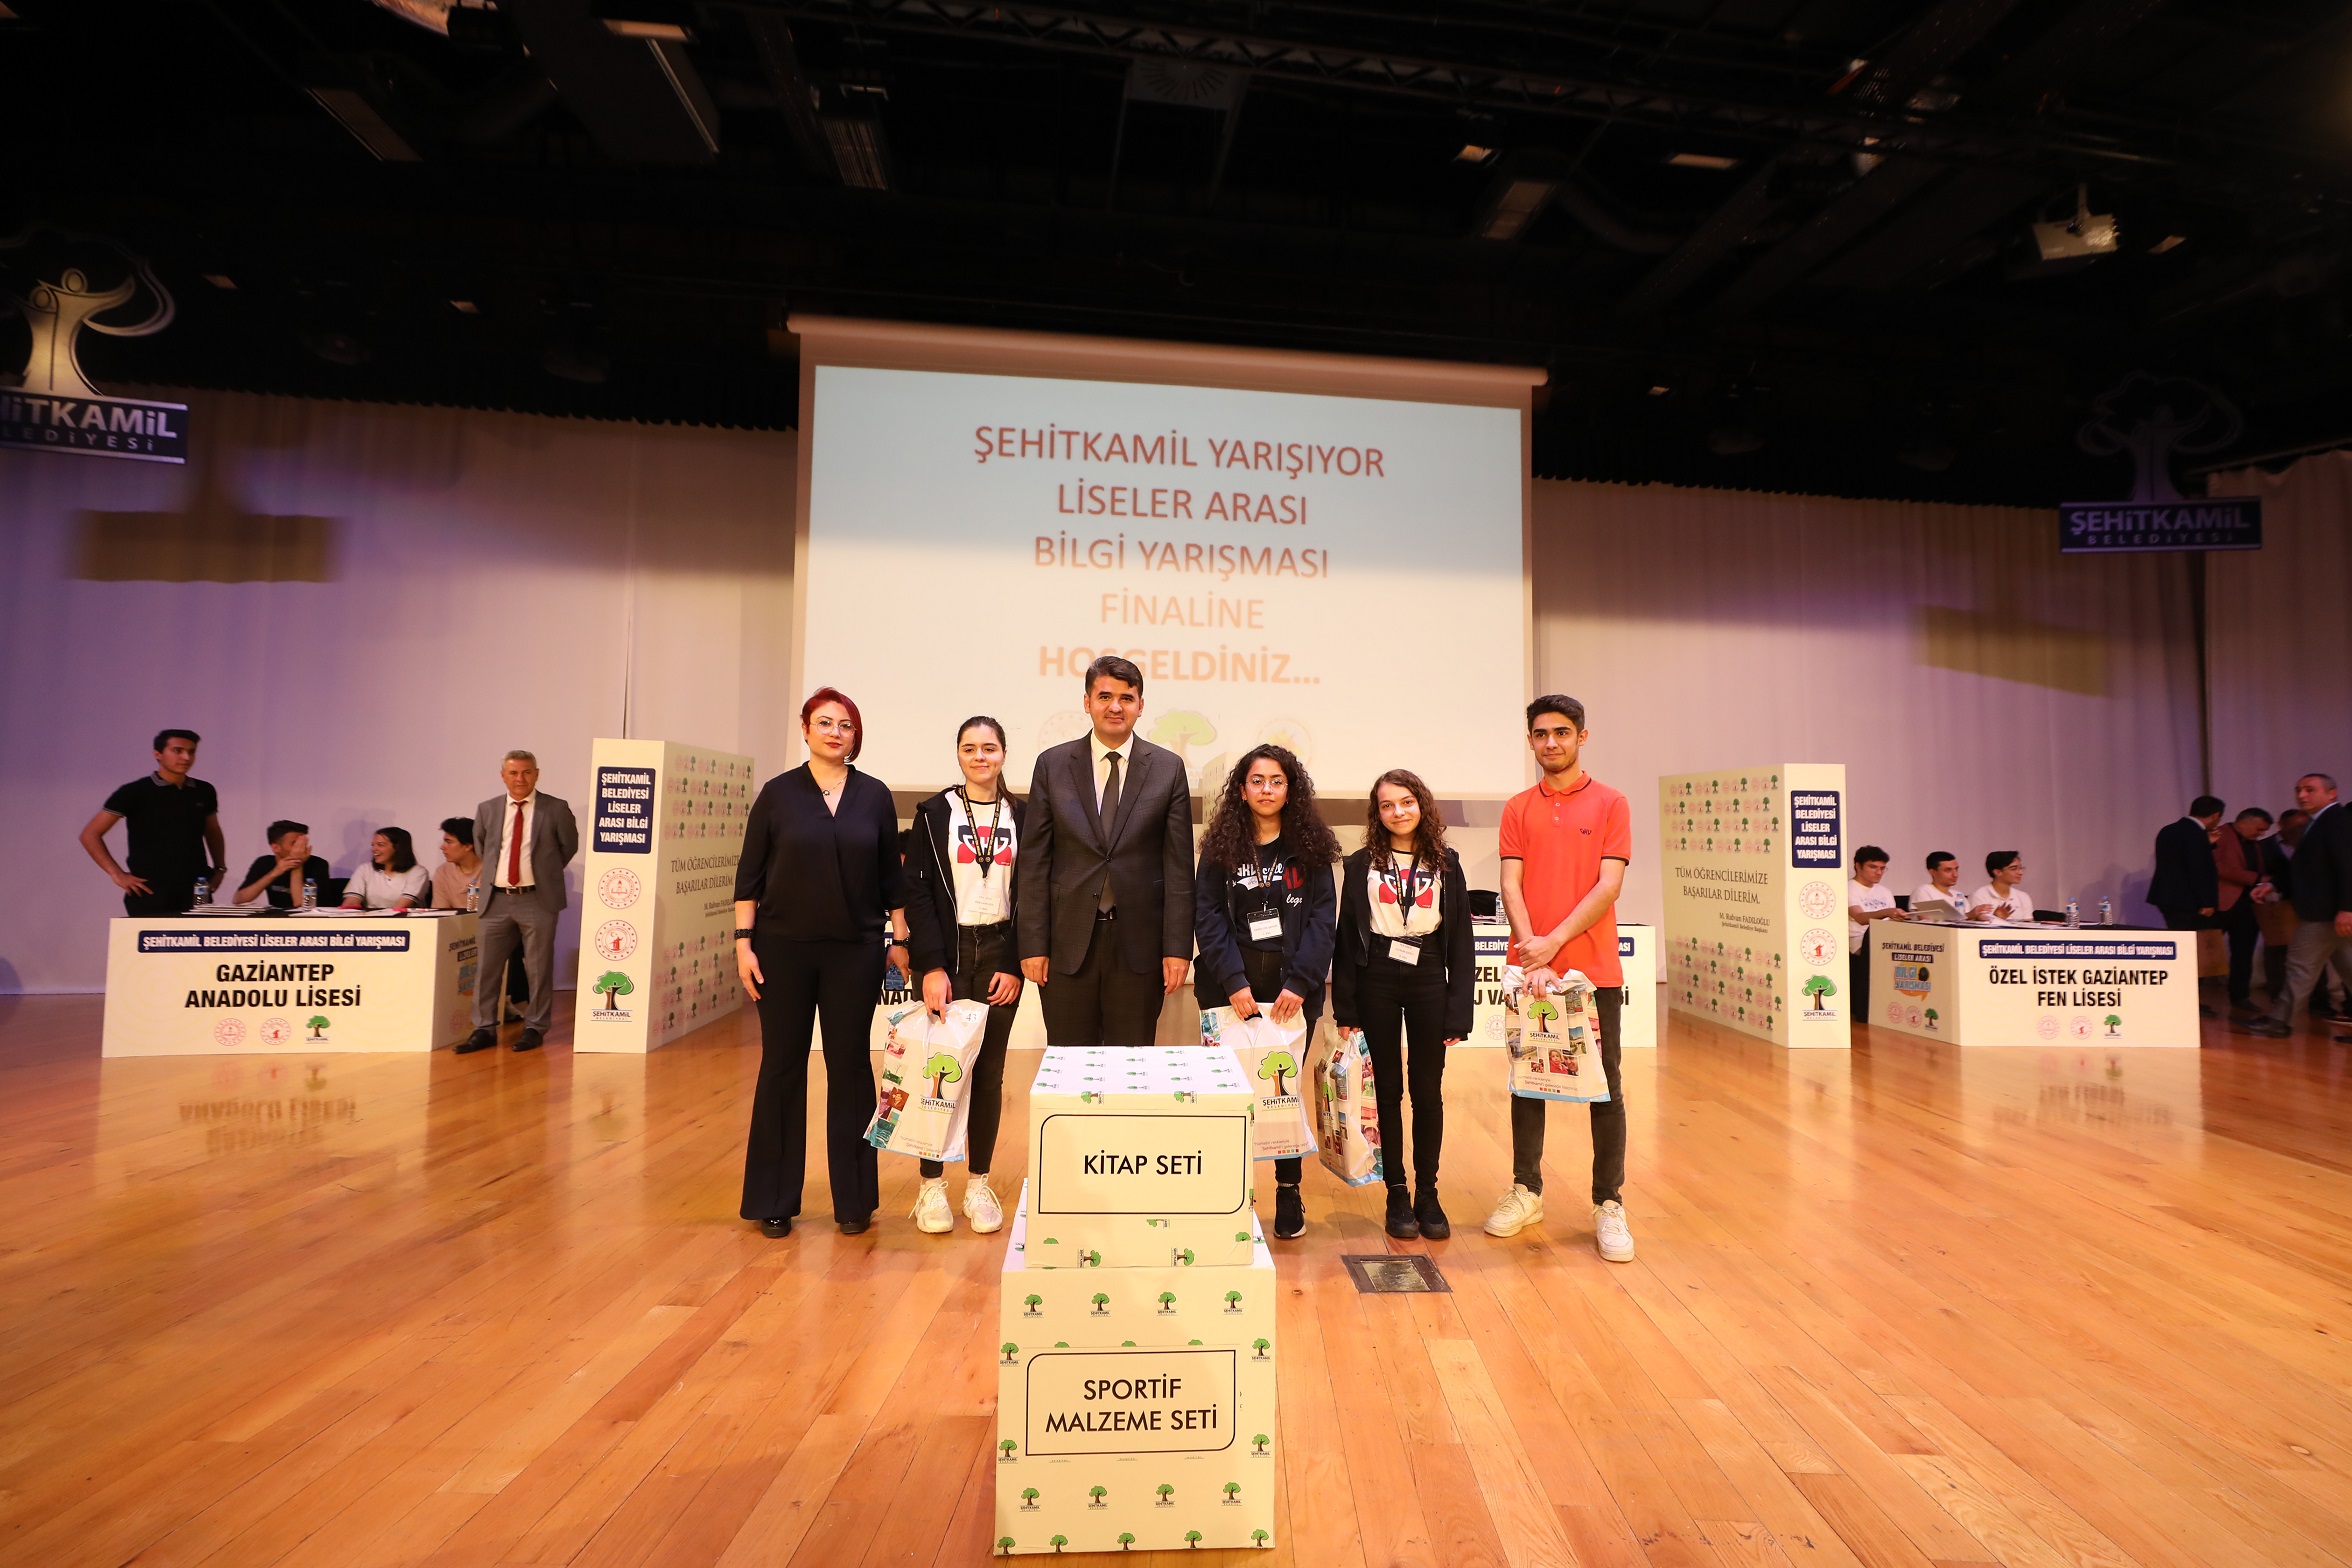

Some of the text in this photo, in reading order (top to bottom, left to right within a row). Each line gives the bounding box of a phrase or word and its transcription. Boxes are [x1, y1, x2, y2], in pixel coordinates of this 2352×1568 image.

[974, 423, 1385, 480] ŞEHİTKAMİL YARIŞIYOR
[1058, 477, 1307, 525] LİSELER ARASI
[1034, 530, 1328, 582] BİLGİ YARIŞMASI
[1100, 587, 1265, 630] FİNALİNE
[601, 771, 651, 786] ŞEHİTKAMİL
[601, 786, 649, 800] BELEDİYESİ
[1794, 794, 1837, 808] ŞEHİTKAMİL
[607, 800, 642, 814] LİSELER
[1795, 808, 1836, 819] BELEDİYESİ
[598, 816, 648, 829] ARASI BİLGİ
[1801, 821, 1831, 833] LİSELER
[600, 831, 646, 846] YARIŞMASI
[1795, 834, 1838, 846] ARASI BİLGİ
[1796, 849, 1836, 862] YARIŞMASI
[671, 858, 686, 873] TÜM
[1675, 866, 1768, 885] TÜM ÖĞRENCİLERİMİZE
[676, 878, 708, 896] BAŞARILAR
[1683, 886, 1761, 904] BAŞARILAR DİLERİM.
[143, 934, 406, 951] ŞEHİTKAMİL BELEDİYESİ LİSELER ARASI BİLGİ YARIŞMASI
[1474, 939, 1509, 952] BELEDİYE
[1982, 943, 2174, 958] ŞEHİTKAMİL BELEDİYESİ LİSELER ARASI BİLGİ YARIŞMASI
[216, 960, 335, 983] GAZİANTEP
[1474, 966, 1502, 982] ZEL
[1989, 965, 2169, 985] ÖZEL İSTEK GAZİANTEP
[184, 984, 362, 1008] ANADOLU LİSESİ
[2038, 988, 2122, 1007] FEN LİSESİ
[966, 1013, 977, 1022] 43
[1084, 1149, 1202, 1175] KİTAP SETİ
[1083, 1373, 1182, 1400] SPORTİF
[1045, 1403, 1218, 1433] MALZEME SETİ
